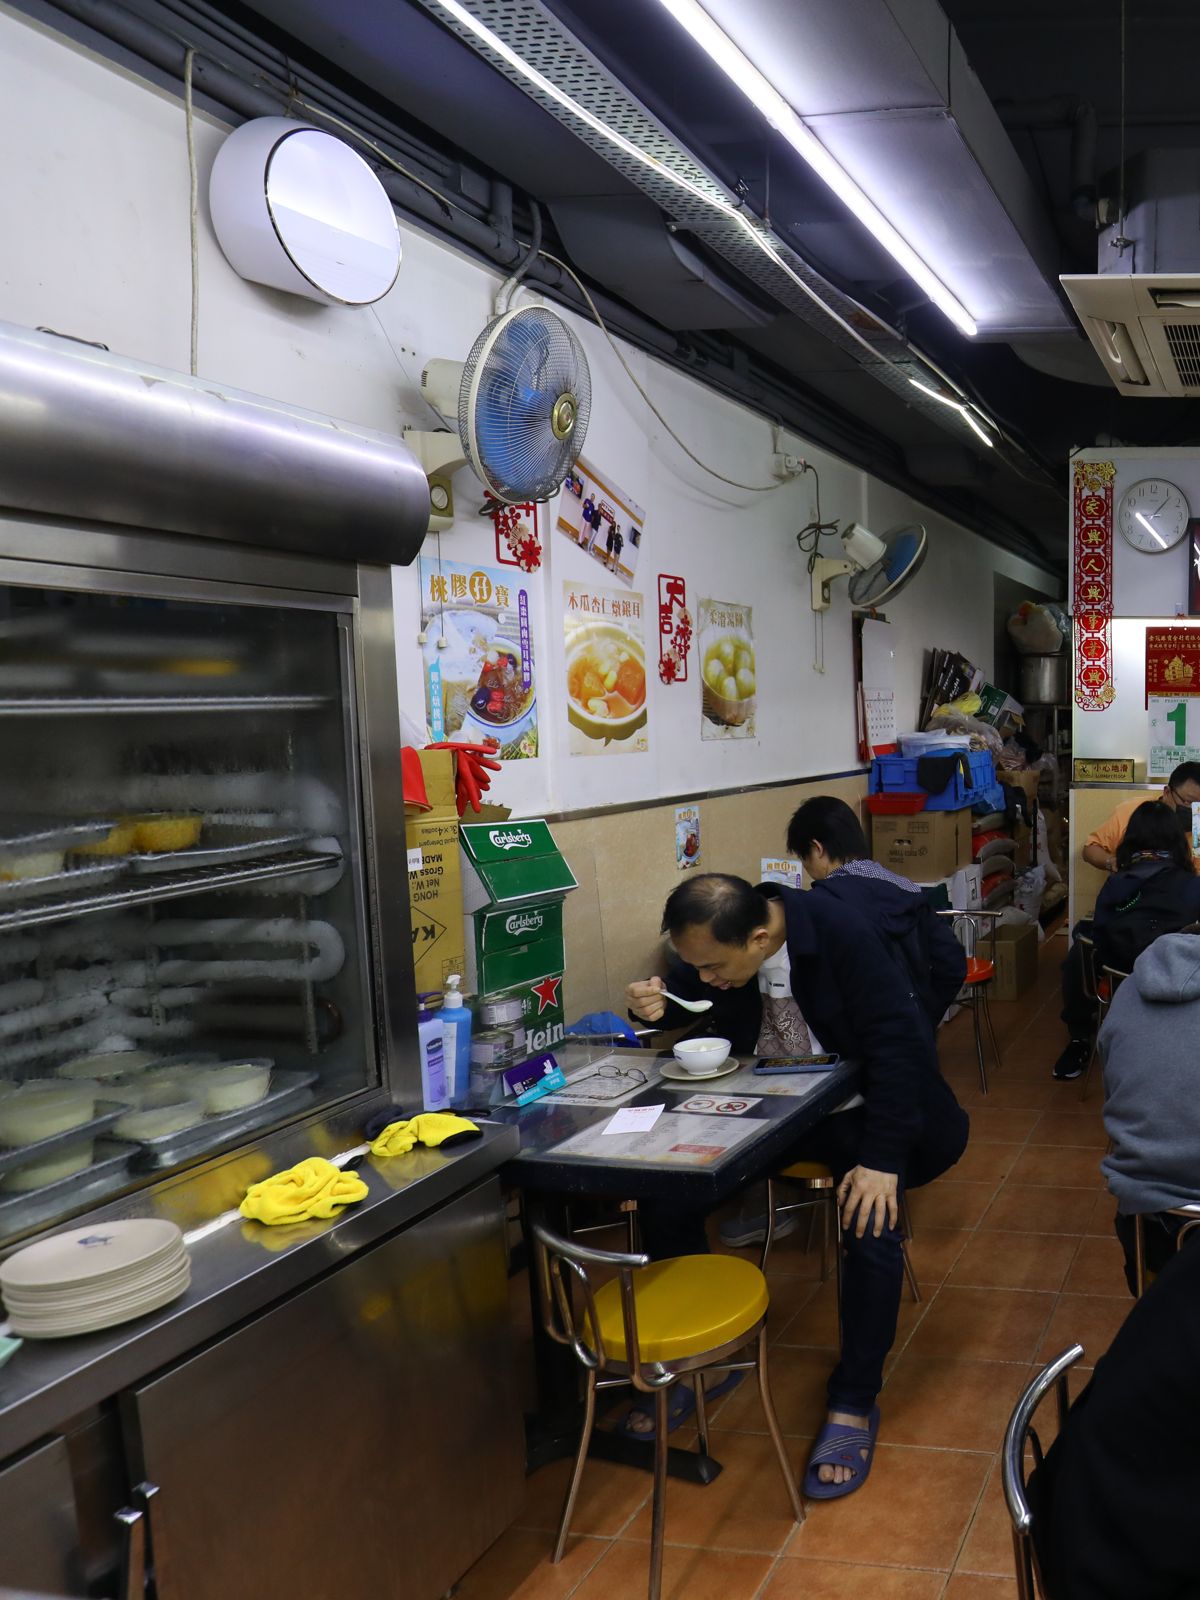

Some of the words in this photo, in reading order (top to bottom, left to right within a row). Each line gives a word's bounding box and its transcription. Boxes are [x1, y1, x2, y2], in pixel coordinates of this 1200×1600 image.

[1139, 487, 1145, 497] 11
[1150, 484, 1158, 493] 12
[1127, 498, 1136, 507] 10
[568, 592, 640, 618] 木瓜杏仁燉銀耳
[1166, 702, 1187, 746] 1
[1093, 763, 1129, 773] 小心地滑
[489, 829, 532, 850] Carlsberg
[420, 866, 444, 877] Gross
[427, 878, 440, 887] Net
[413, 889, 439, 902] HONG
[506, 911, 543, 935] Carlsberg
